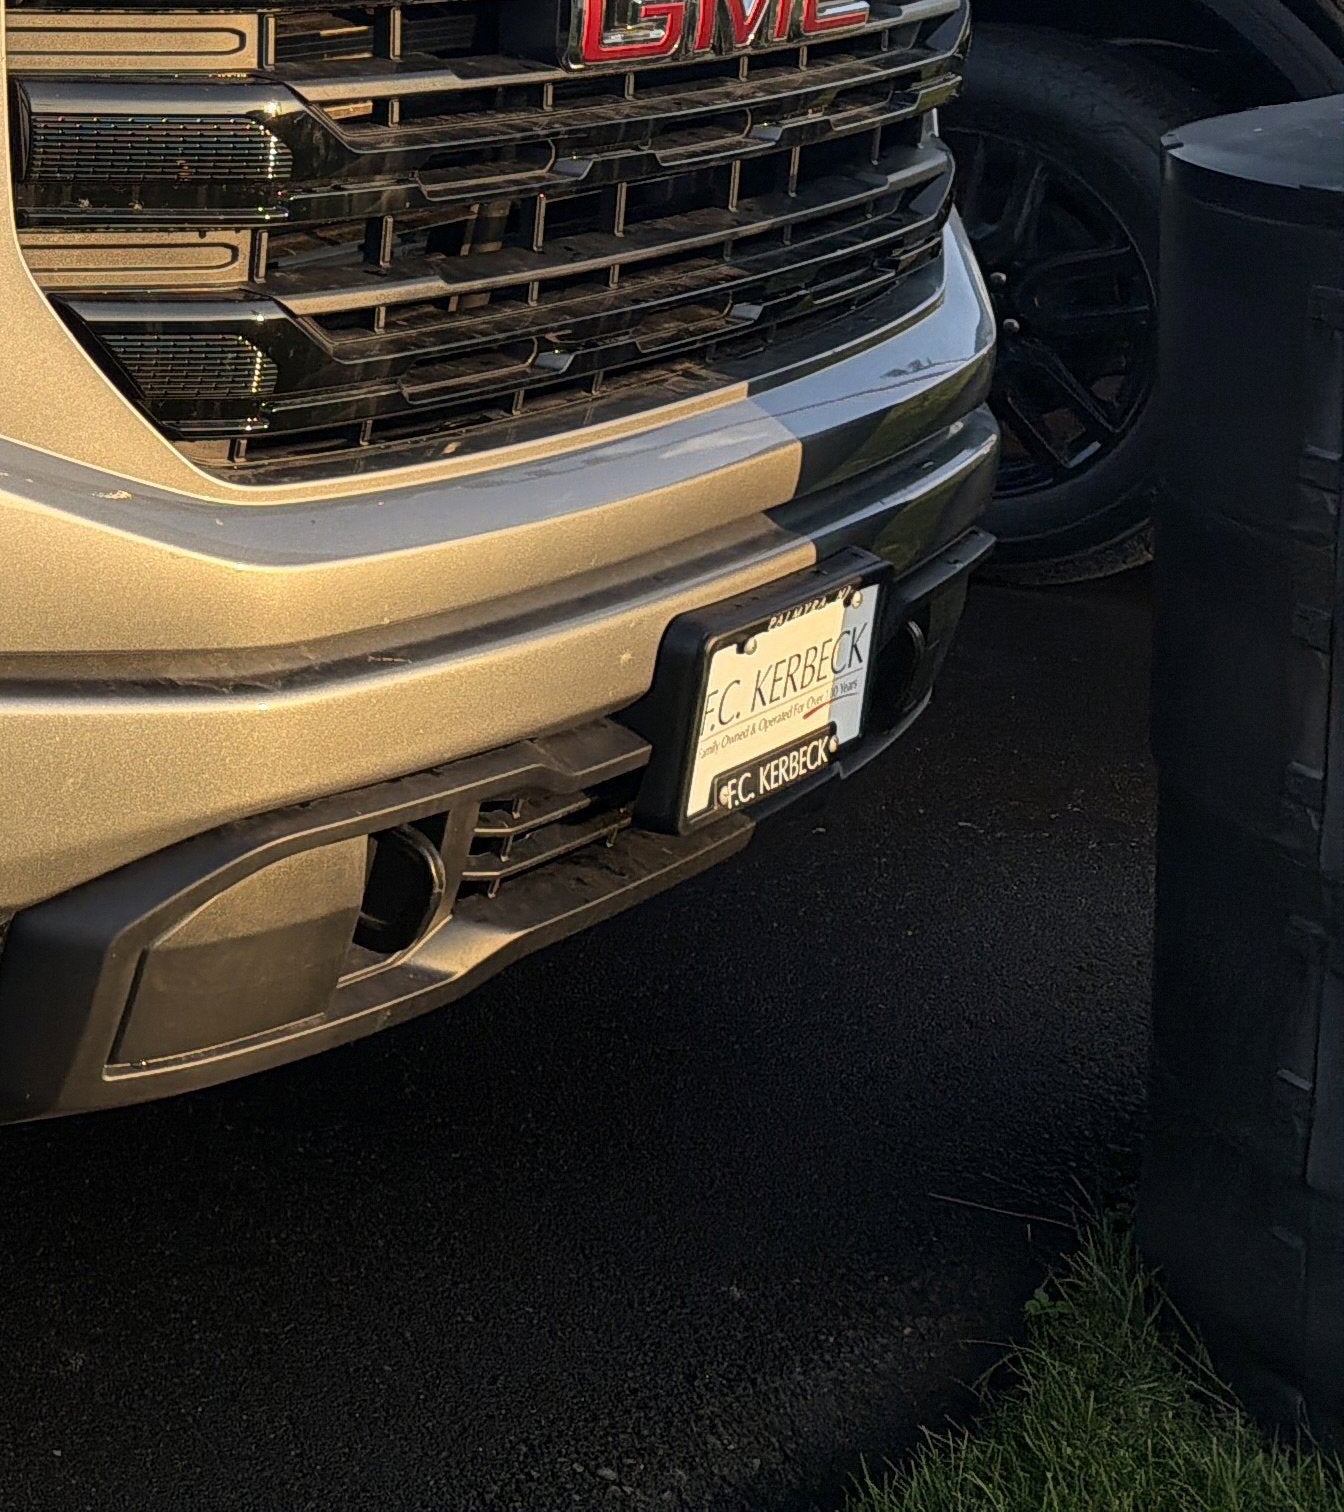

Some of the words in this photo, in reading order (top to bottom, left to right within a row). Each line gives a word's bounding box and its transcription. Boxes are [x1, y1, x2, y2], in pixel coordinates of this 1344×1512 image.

[700, 679, 741, 736] F.C.
[750, 622, 868, 713] KERBECK
[721, 724, 751, 749] Owned
[758, 705, 792, 733] Operated
[793, 701, 805, 715] For
[806, 693, 824, 709] Over
[840, 679, 858, 694] Years
[726, 772, 755, 810] F.C.
[759, 735, 829, 795] KERBECK
